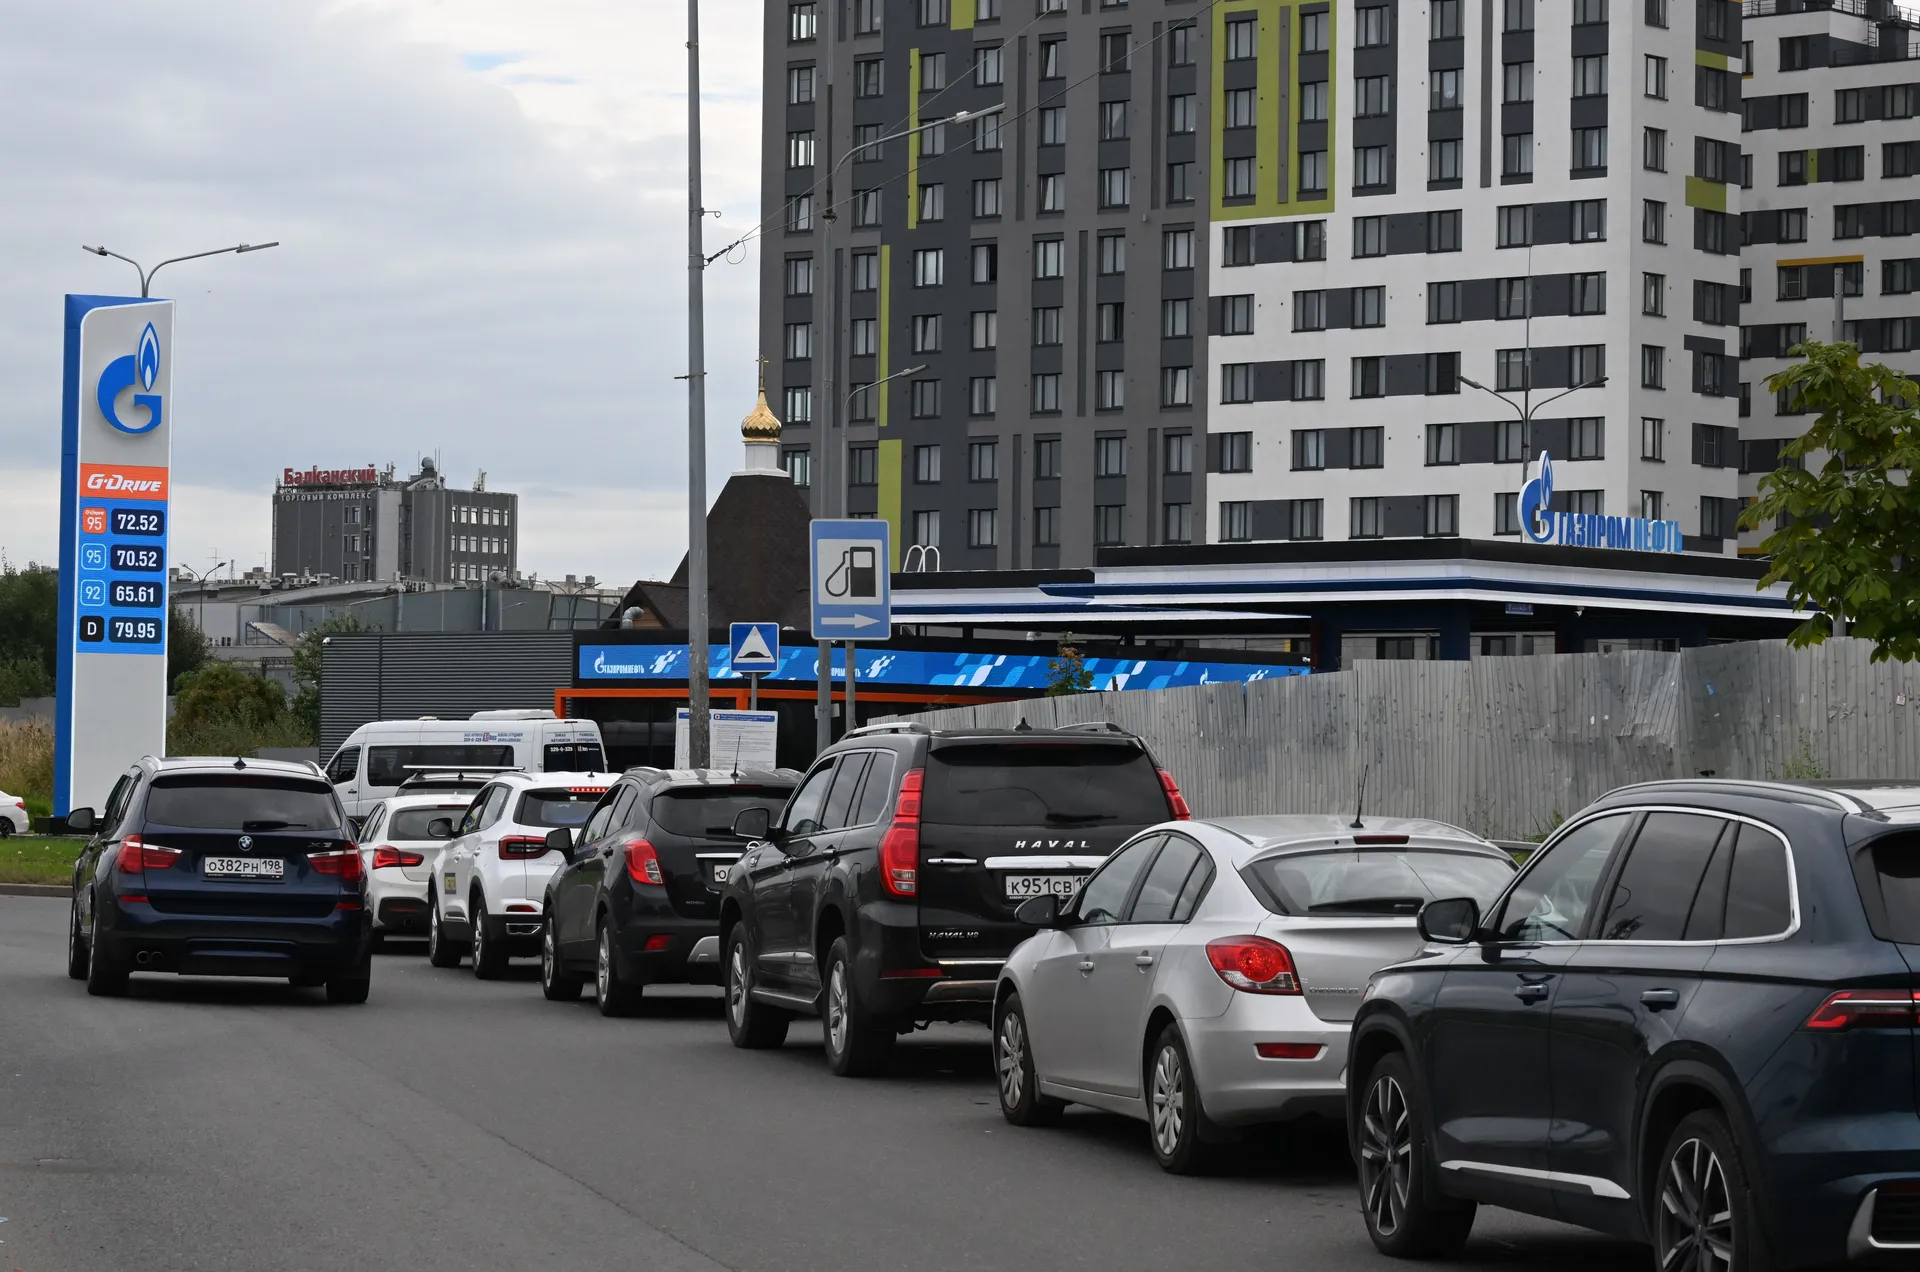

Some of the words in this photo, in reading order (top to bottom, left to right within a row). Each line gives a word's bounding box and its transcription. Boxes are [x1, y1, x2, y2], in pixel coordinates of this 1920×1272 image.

[284, 464, 376, 485] Балканский
[281, 492, 323, 502] ТОРГОВЫЙ
[327, 492, 371, 501] КОМПЛЕКС
[87, 516, 102, 531] 95
[118, 514, 158, 531] 72.52
[1558, 511, 1683, 553] ГАЗПРОМНЕФТЬ
[86, 549, 102, 564] 95
[117, 550, 157, 567] 70.52
[85, 586, 101, 600] 92
[116, 586, 154, 602] 65.61
[87, 621, 97, 636] D
[115, 622, 155, 638] 79.95
[604, 664, 645, 674] ГАЗПРОМНЕФТЬ
[262, 860, 280, 870] 198
